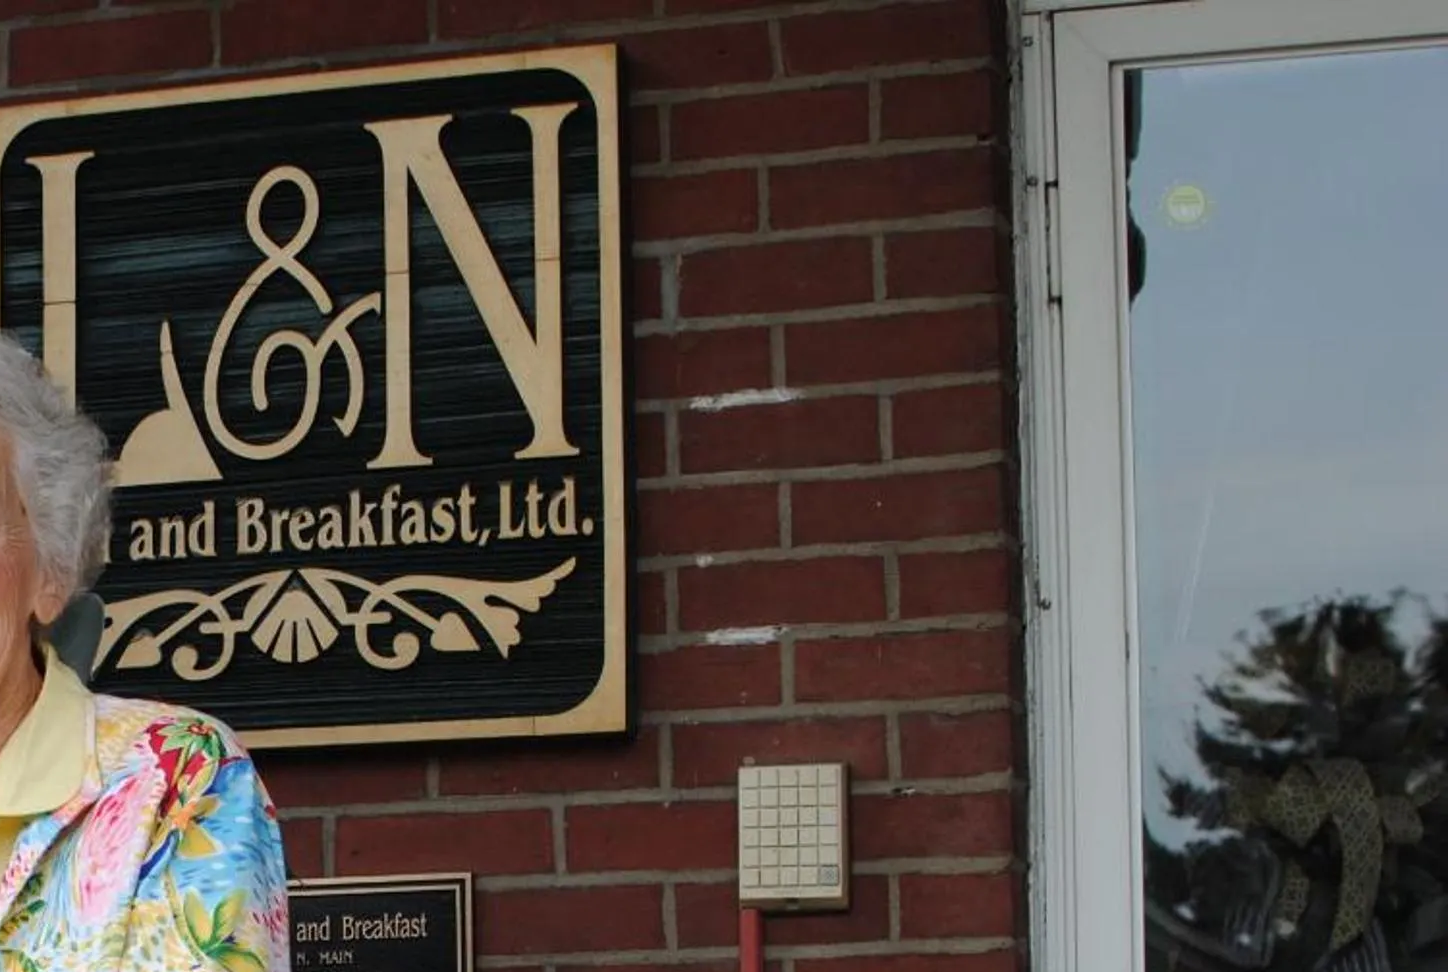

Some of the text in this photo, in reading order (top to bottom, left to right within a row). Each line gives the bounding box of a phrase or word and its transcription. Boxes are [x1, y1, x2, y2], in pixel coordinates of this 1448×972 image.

[130, 502, 216, 562] and
[296, 912, 427, 942] and Breakfast
[318, 949, 354, 965] MAIN
